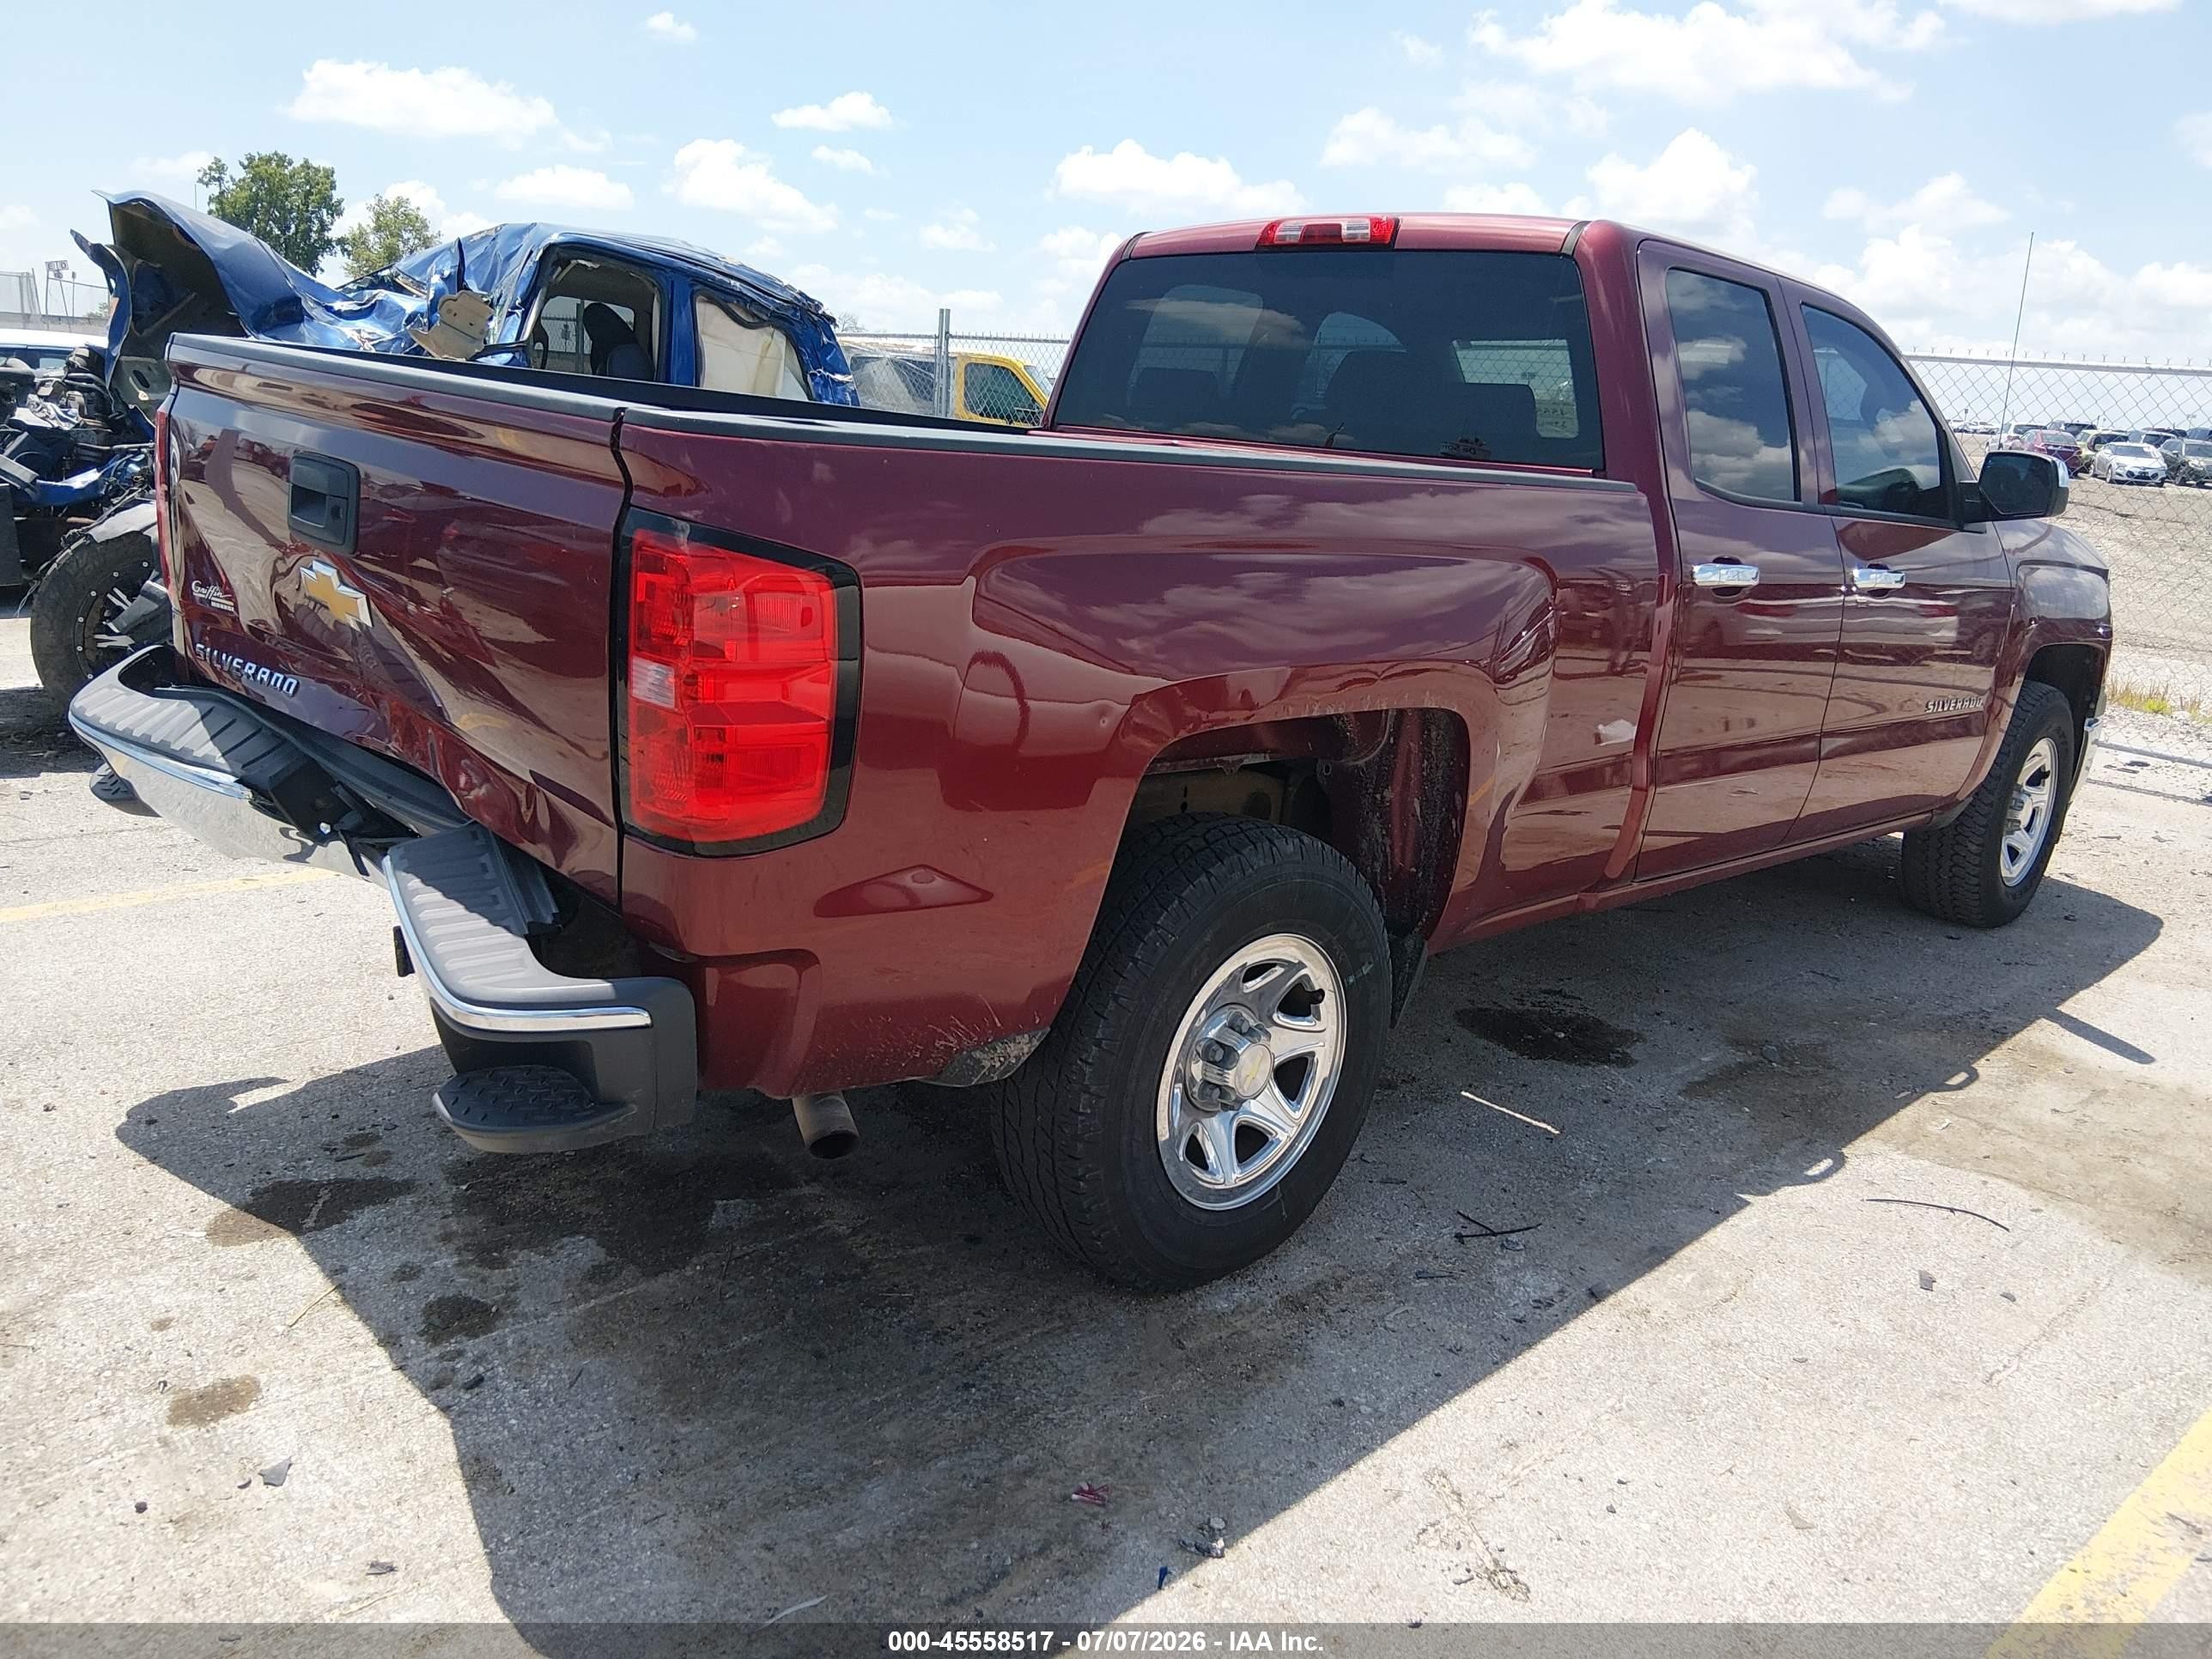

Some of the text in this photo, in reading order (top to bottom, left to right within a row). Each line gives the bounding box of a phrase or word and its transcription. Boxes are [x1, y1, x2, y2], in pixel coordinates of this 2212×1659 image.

[191, 580, 232, 600] Griffin
[195, 643, 300, 696] SILVERADO
[1925, 697, 1984, 714] SILVERADO
